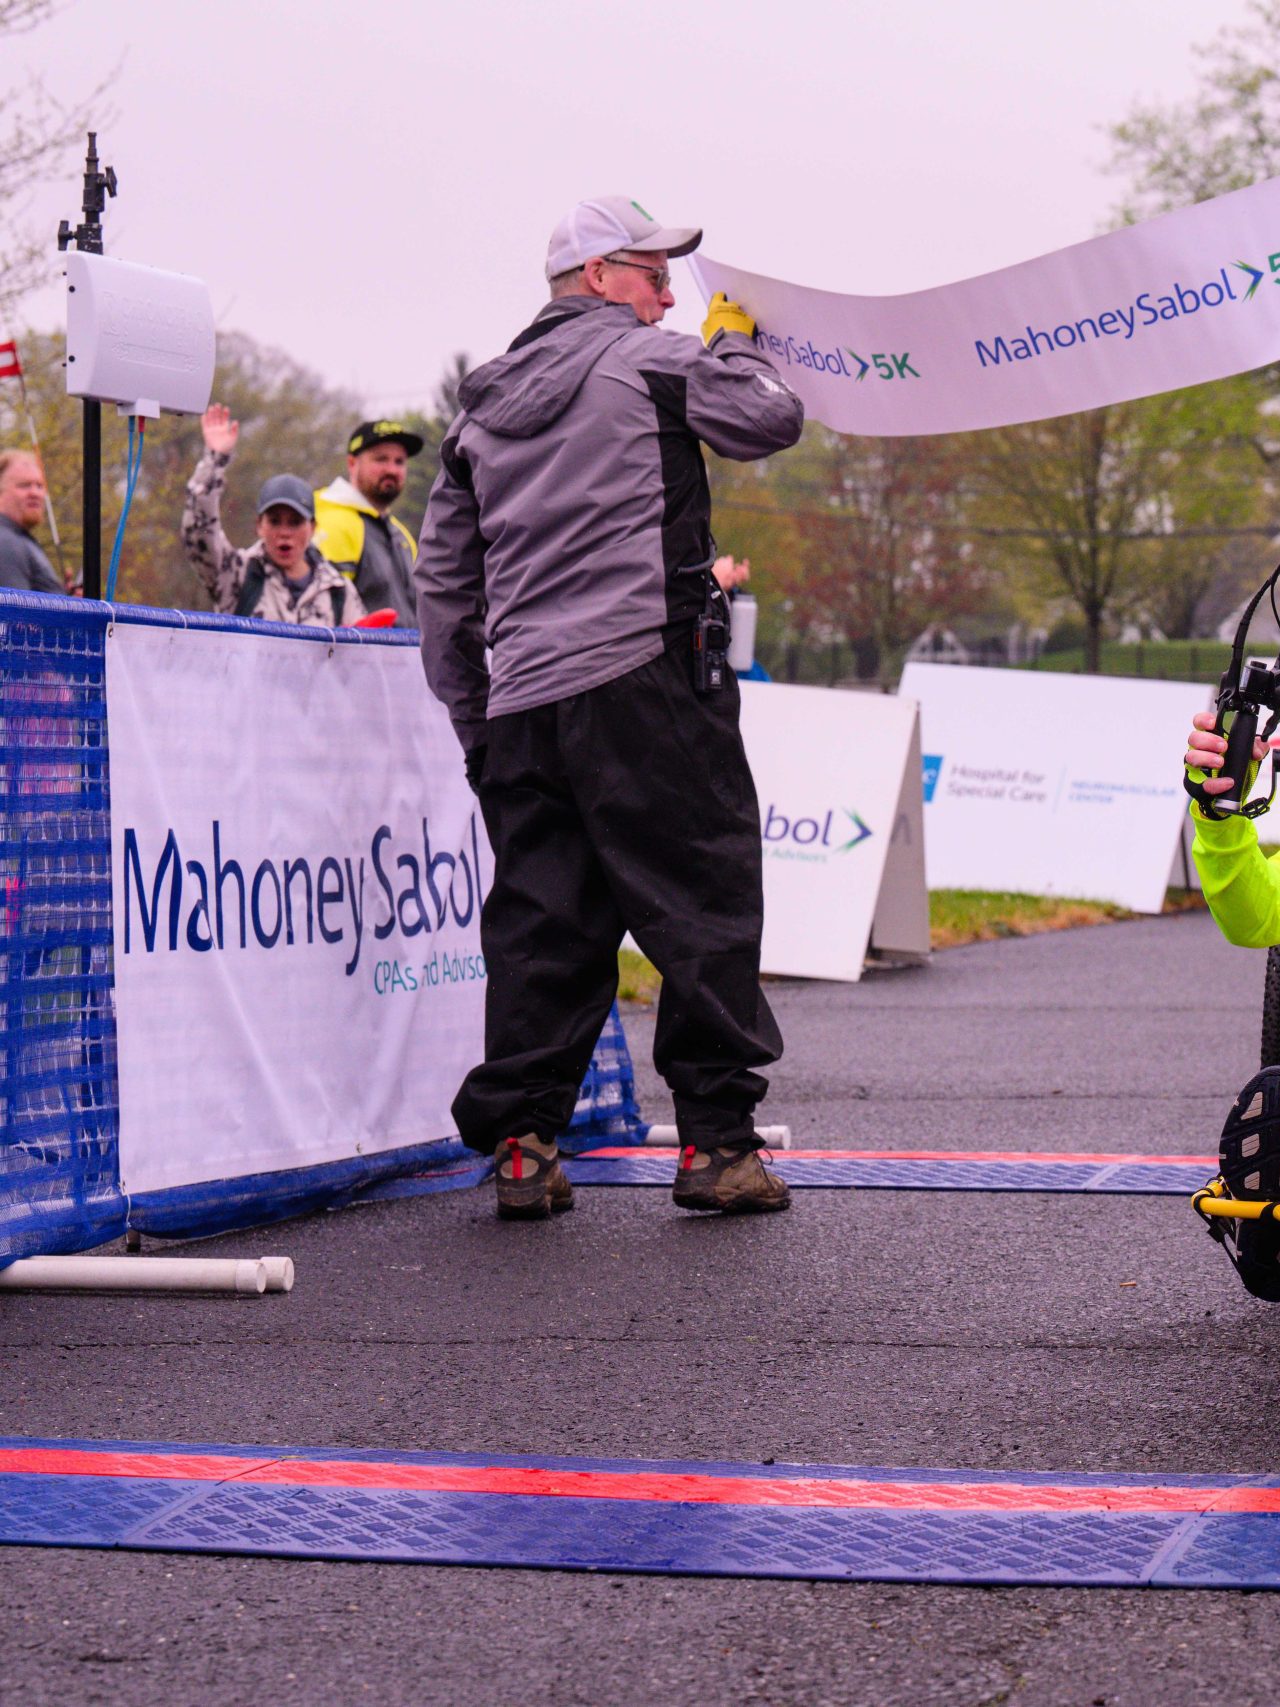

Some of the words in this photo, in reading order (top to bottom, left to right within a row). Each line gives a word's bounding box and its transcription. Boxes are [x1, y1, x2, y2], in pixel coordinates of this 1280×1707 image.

[974, 268, 1237, 367] MahoneySabol
[757, 330, 852, 377] neySabol
[871, 352, 921, 380] 5K
[948, 781, 1006, 801] Special
[1010, 784, 1047, 803] Care
[950, 765, 1017, 784] Hospital
[1022, 770, 1045, 784] for
[763, 804, 832, 847] bol
[124, 812, 486, 976] MahoneySabol
[374, 959, 418, 995] CPAs
[442, 948, 486, 984] Adviso
